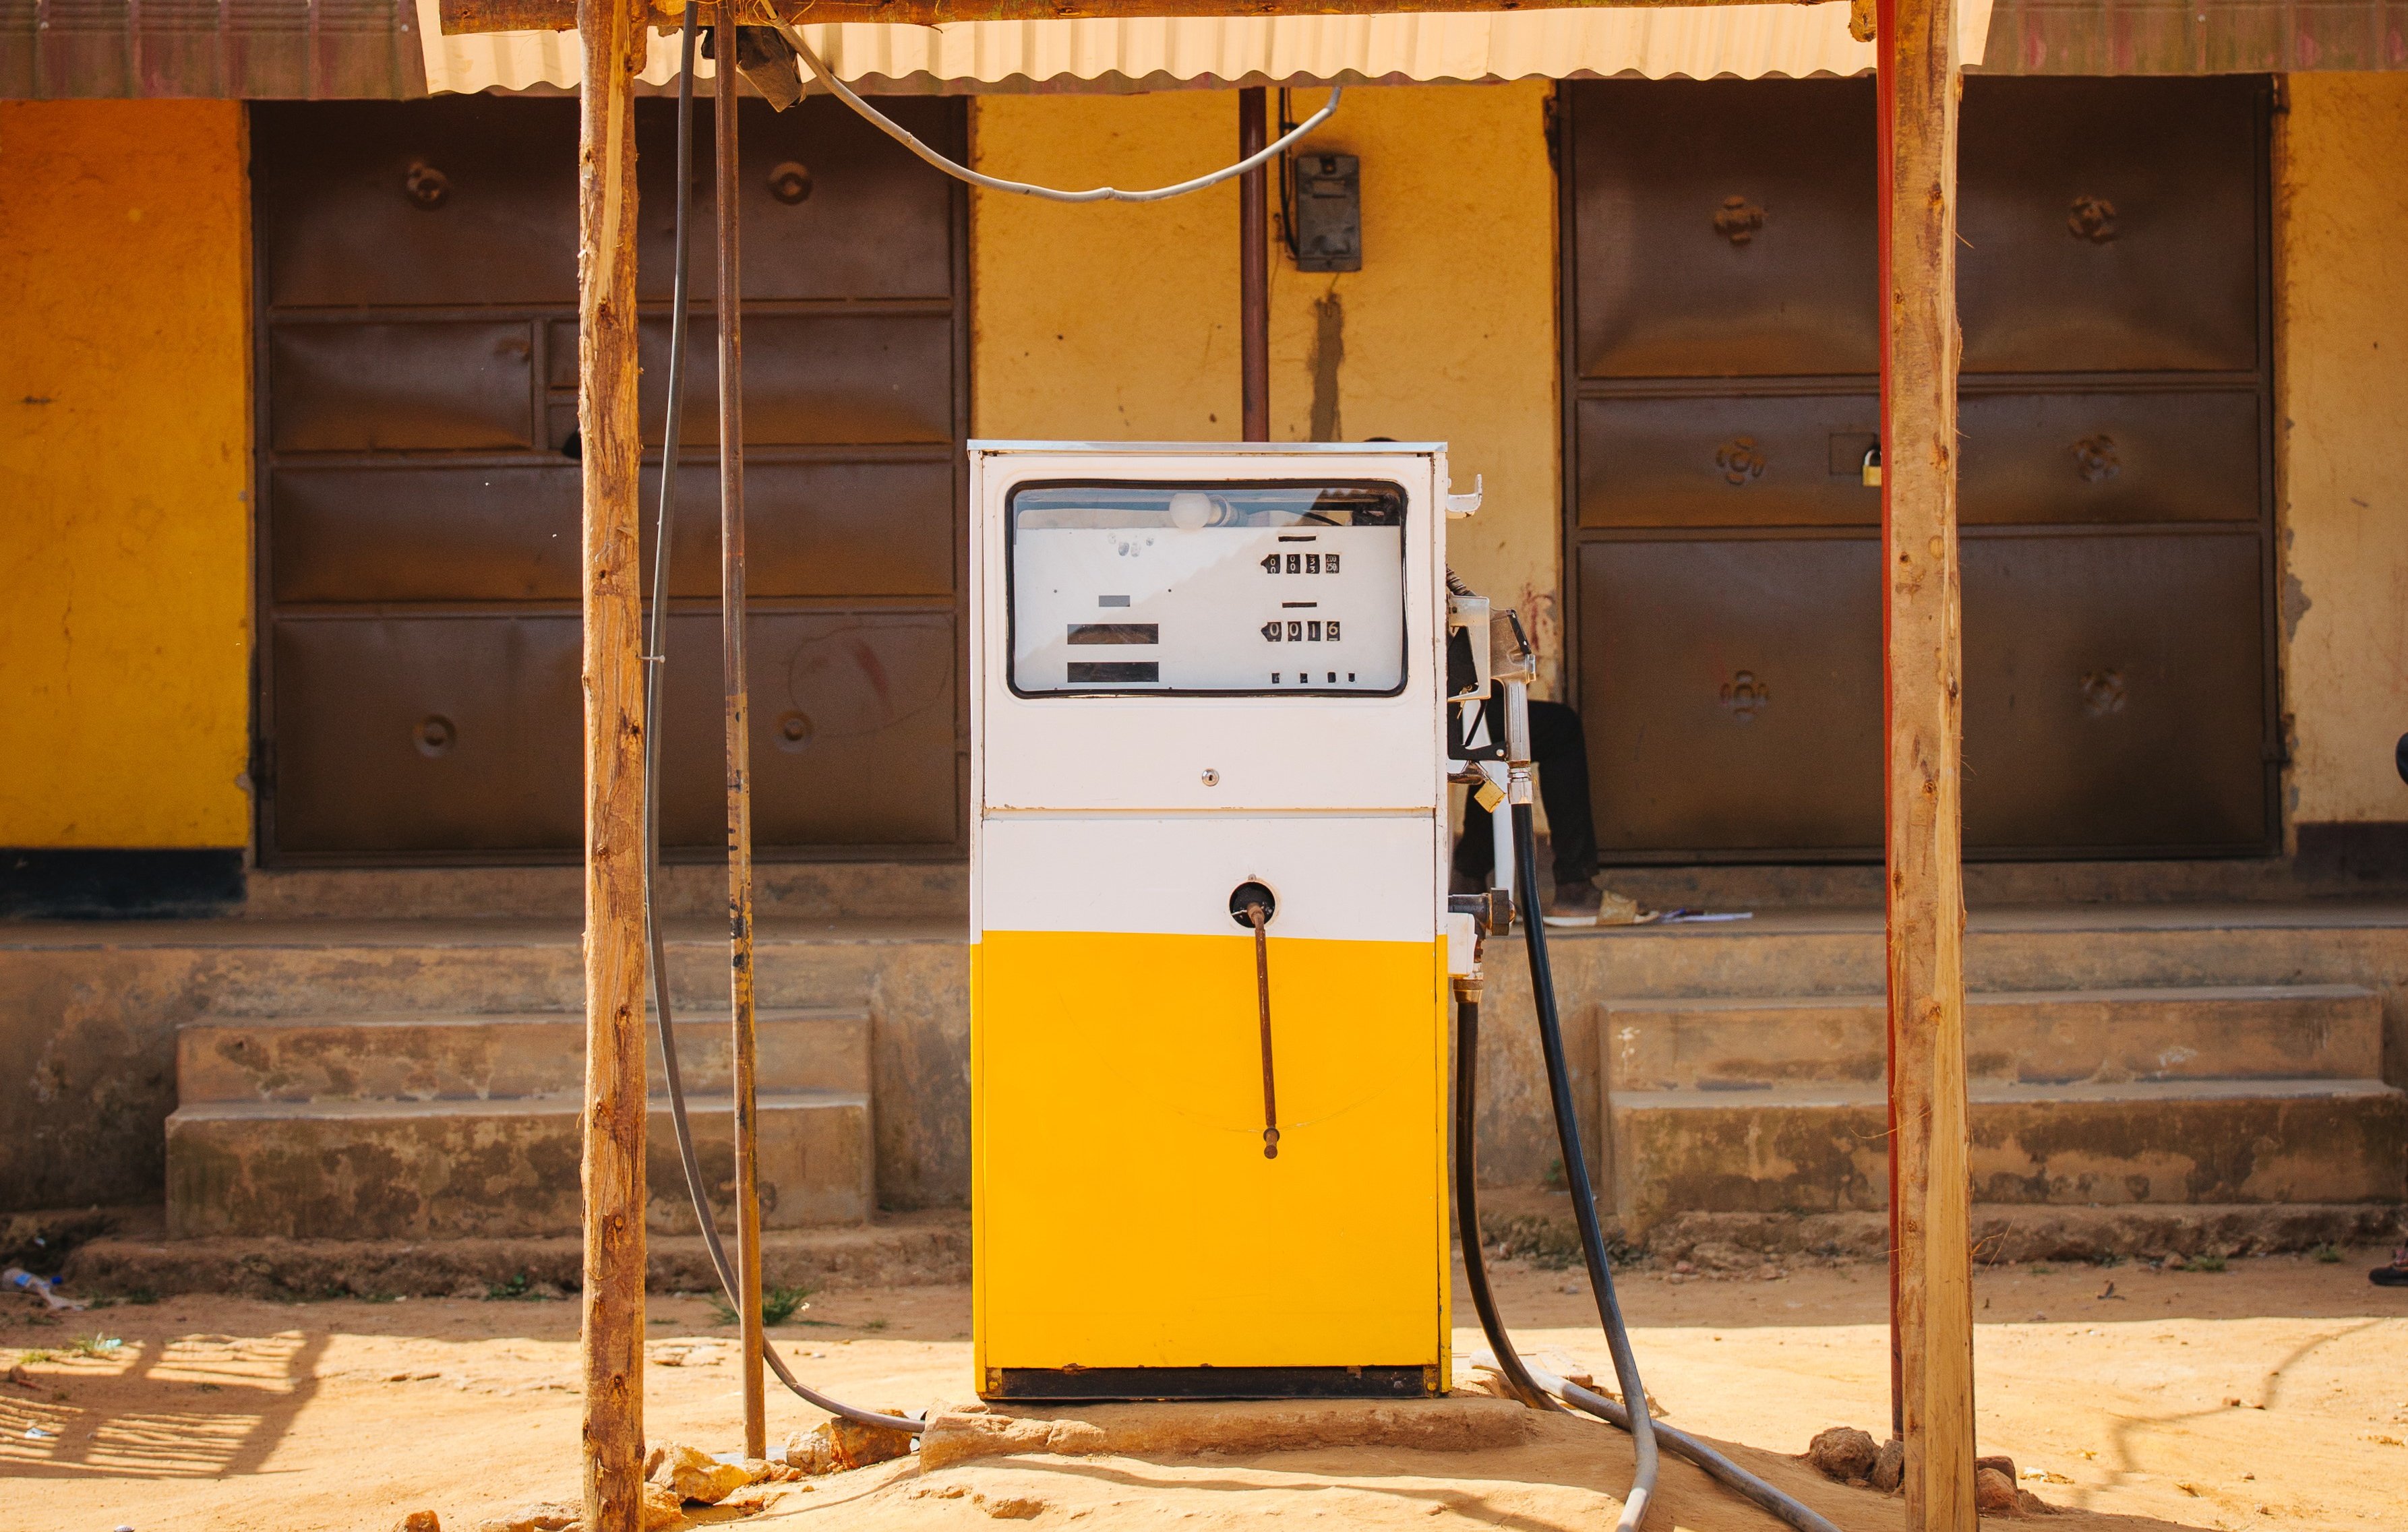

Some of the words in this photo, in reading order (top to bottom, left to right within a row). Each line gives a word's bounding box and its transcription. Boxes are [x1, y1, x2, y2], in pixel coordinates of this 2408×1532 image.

[1290, 563, 1296, 571] 0
[1270, 623, 1279, 636] 0
[1289, 623, 1298, 636] 0
[1328, 623, 1338, 636] 6
